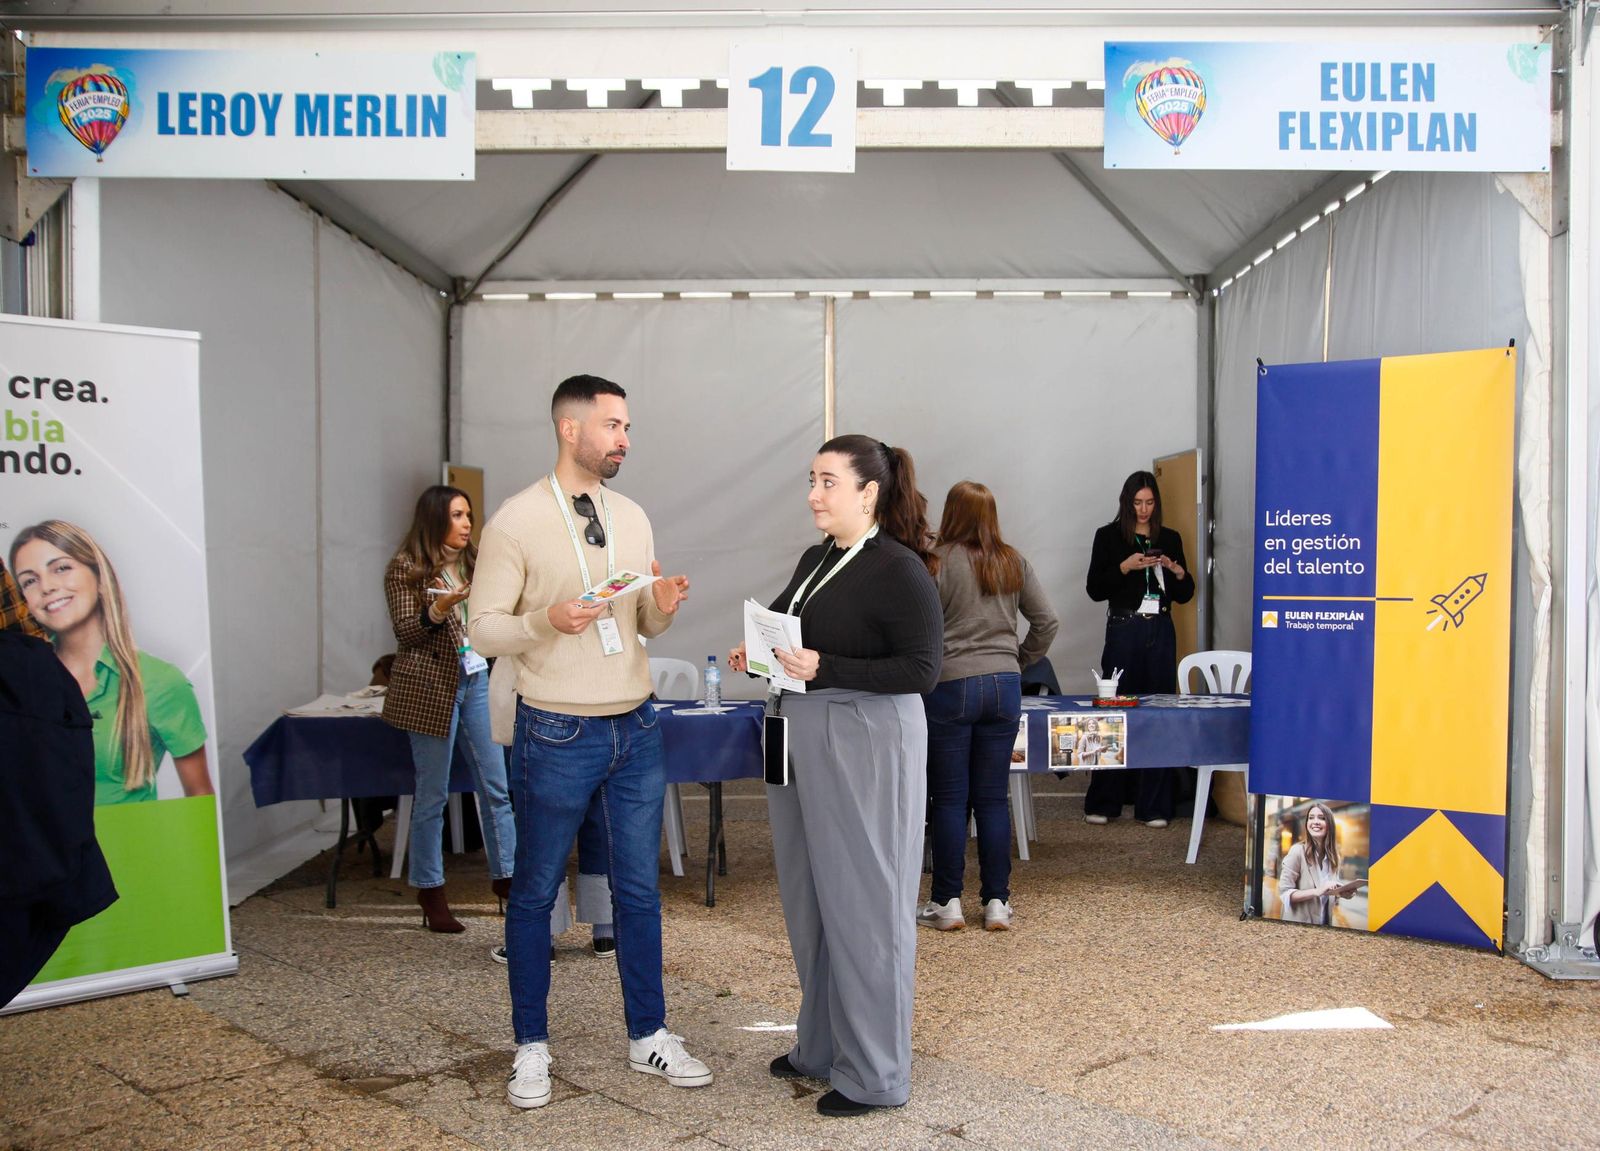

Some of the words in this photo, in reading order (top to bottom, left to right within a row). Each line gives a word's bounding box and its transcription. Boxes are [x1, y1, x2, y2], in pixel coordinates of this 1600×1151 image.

[1319, 62, 1435, 103] EULEN
[69, 97, 89, 111] FERIA
[93, 95, 120, 107] EMPLEO
[1147, 90, 1166, 104] FERIA
[1170, 87, 1197, 100] EMPLEO
[79, 109, 111, 120] 2025
[156, 91, 283, 137] LEROY
[294, 93, 447, 138] MERLIN
[748, 65, 836, 148] 12
[1159, 101, 1188, 113] 2025
[1278, 111, 1478, 153] FLEXIPLAN
[8, 374, 109, 403] crea.
[0, 409, 65, 443] bia
[0, 443, 82, 475] ndo.
[1264, 510, 1332, 527] Líderes
[1264, 537, 1286, 551] en
[1291, 533, 1361, 555] gestión
[1263, 558, 1292, 575] del
[1296, 558, 1365, 575] talento
[1285, 611, 1313, 620] EULEN
[1315, 610, 1364, 621] FLEXIPLÁN
[1285, 621, 1314, 631] Trabajo
[1316, 622, 1354, 632] temporal
